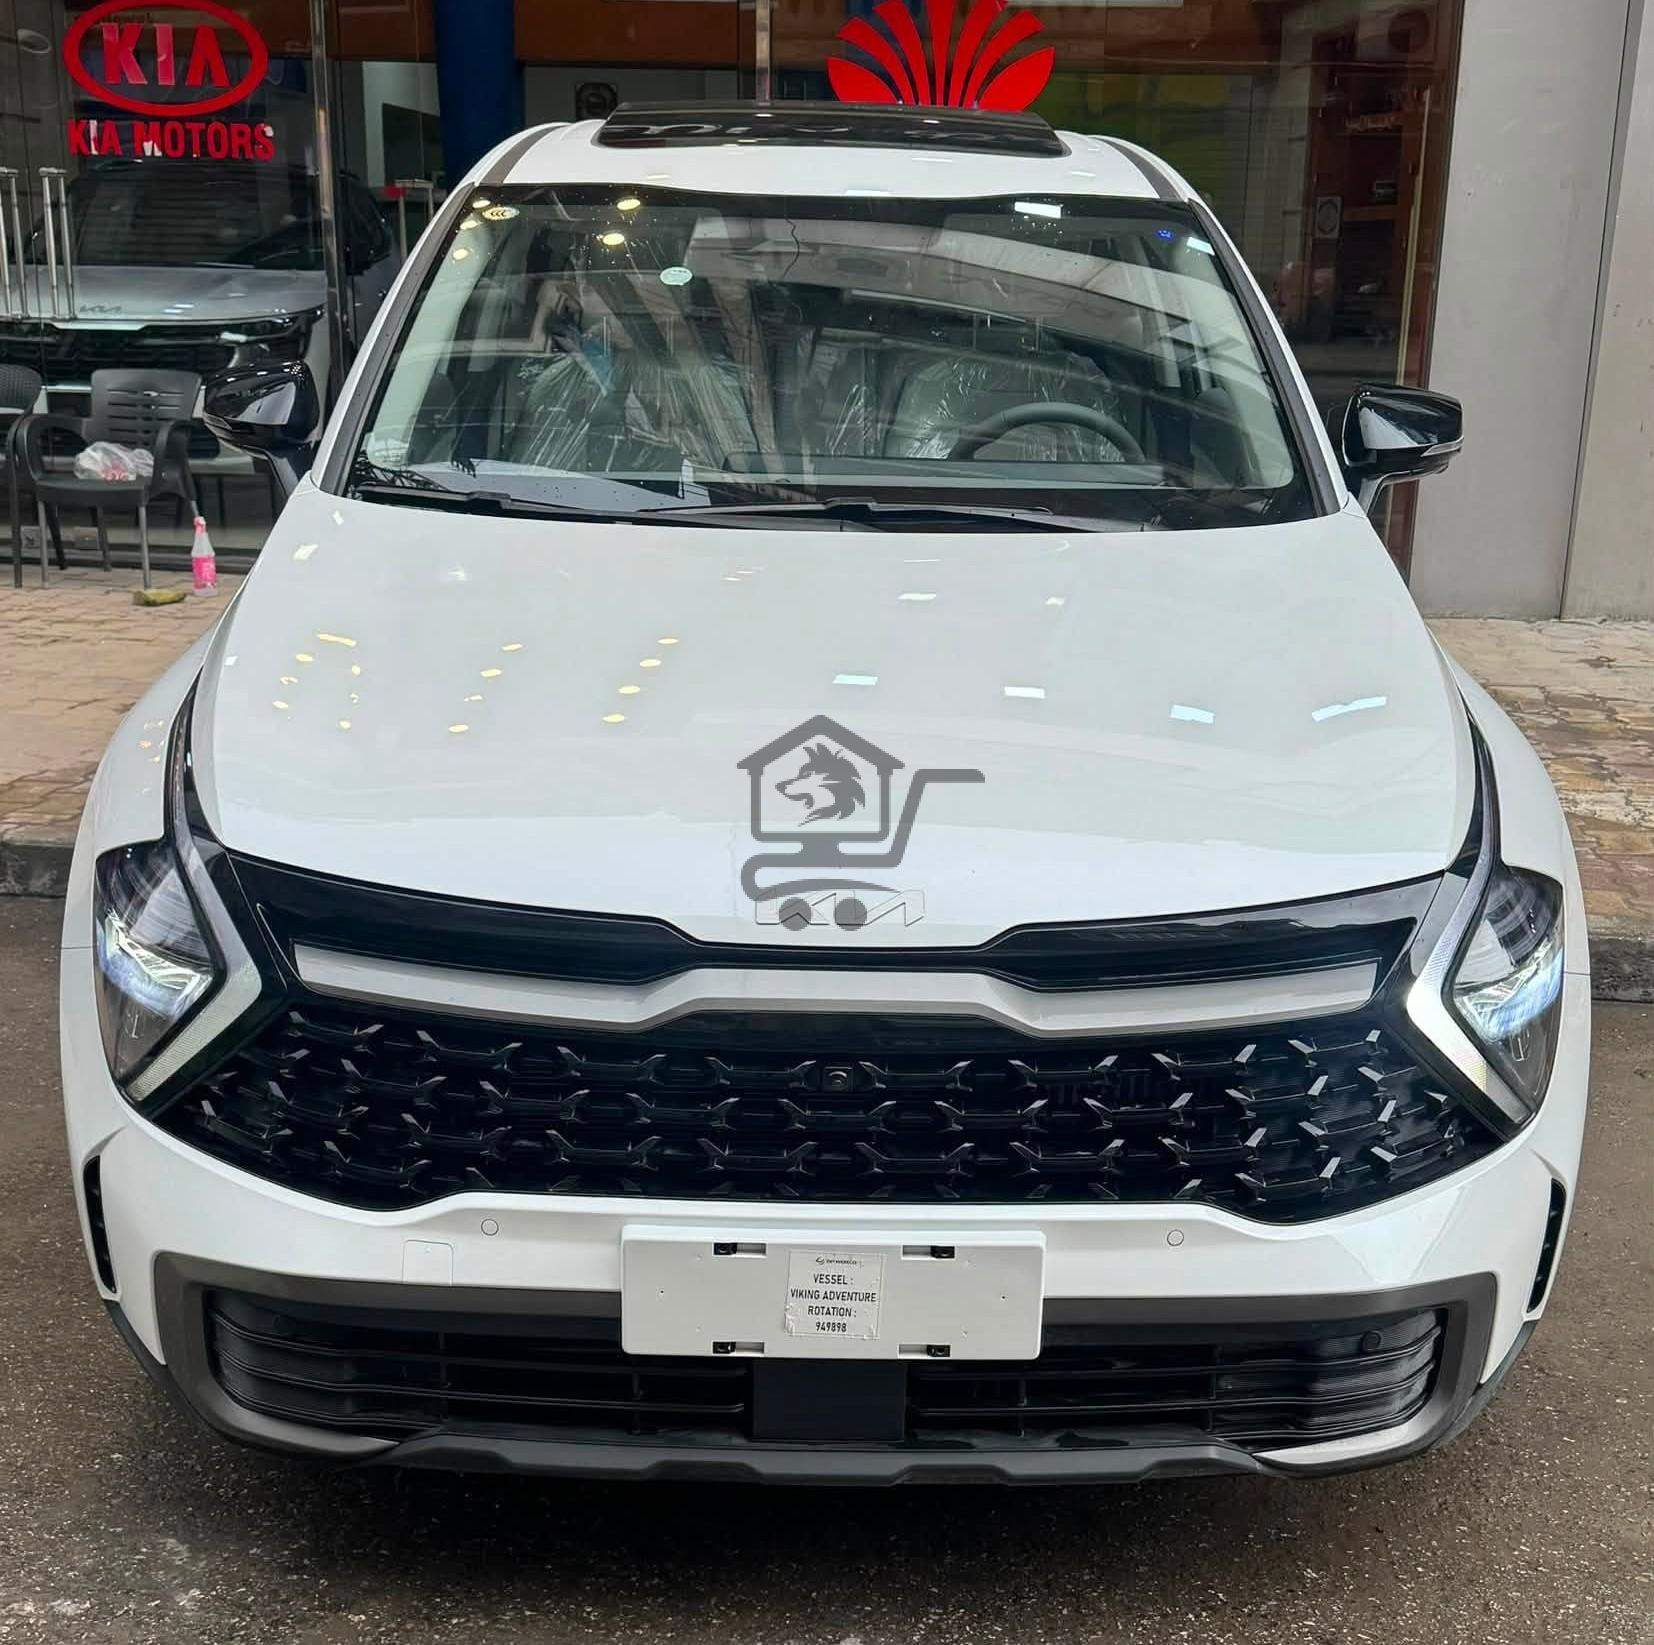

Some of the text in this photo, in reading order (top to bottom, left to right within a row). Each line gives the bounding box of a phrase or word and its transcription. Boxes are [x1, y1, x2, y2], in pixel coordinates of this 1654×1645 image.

[102, 24, 230, 87] KIA
[68, 120, 275, 160] KIA MOTORS
[813, 1273, 848, 1285] VESSEL
[790, 1288, 877, 1302] VIKING ADVENTURE
[807, 1305, 852, 1317] ROTATION
[815, 1321, 848, 1332] 949898
